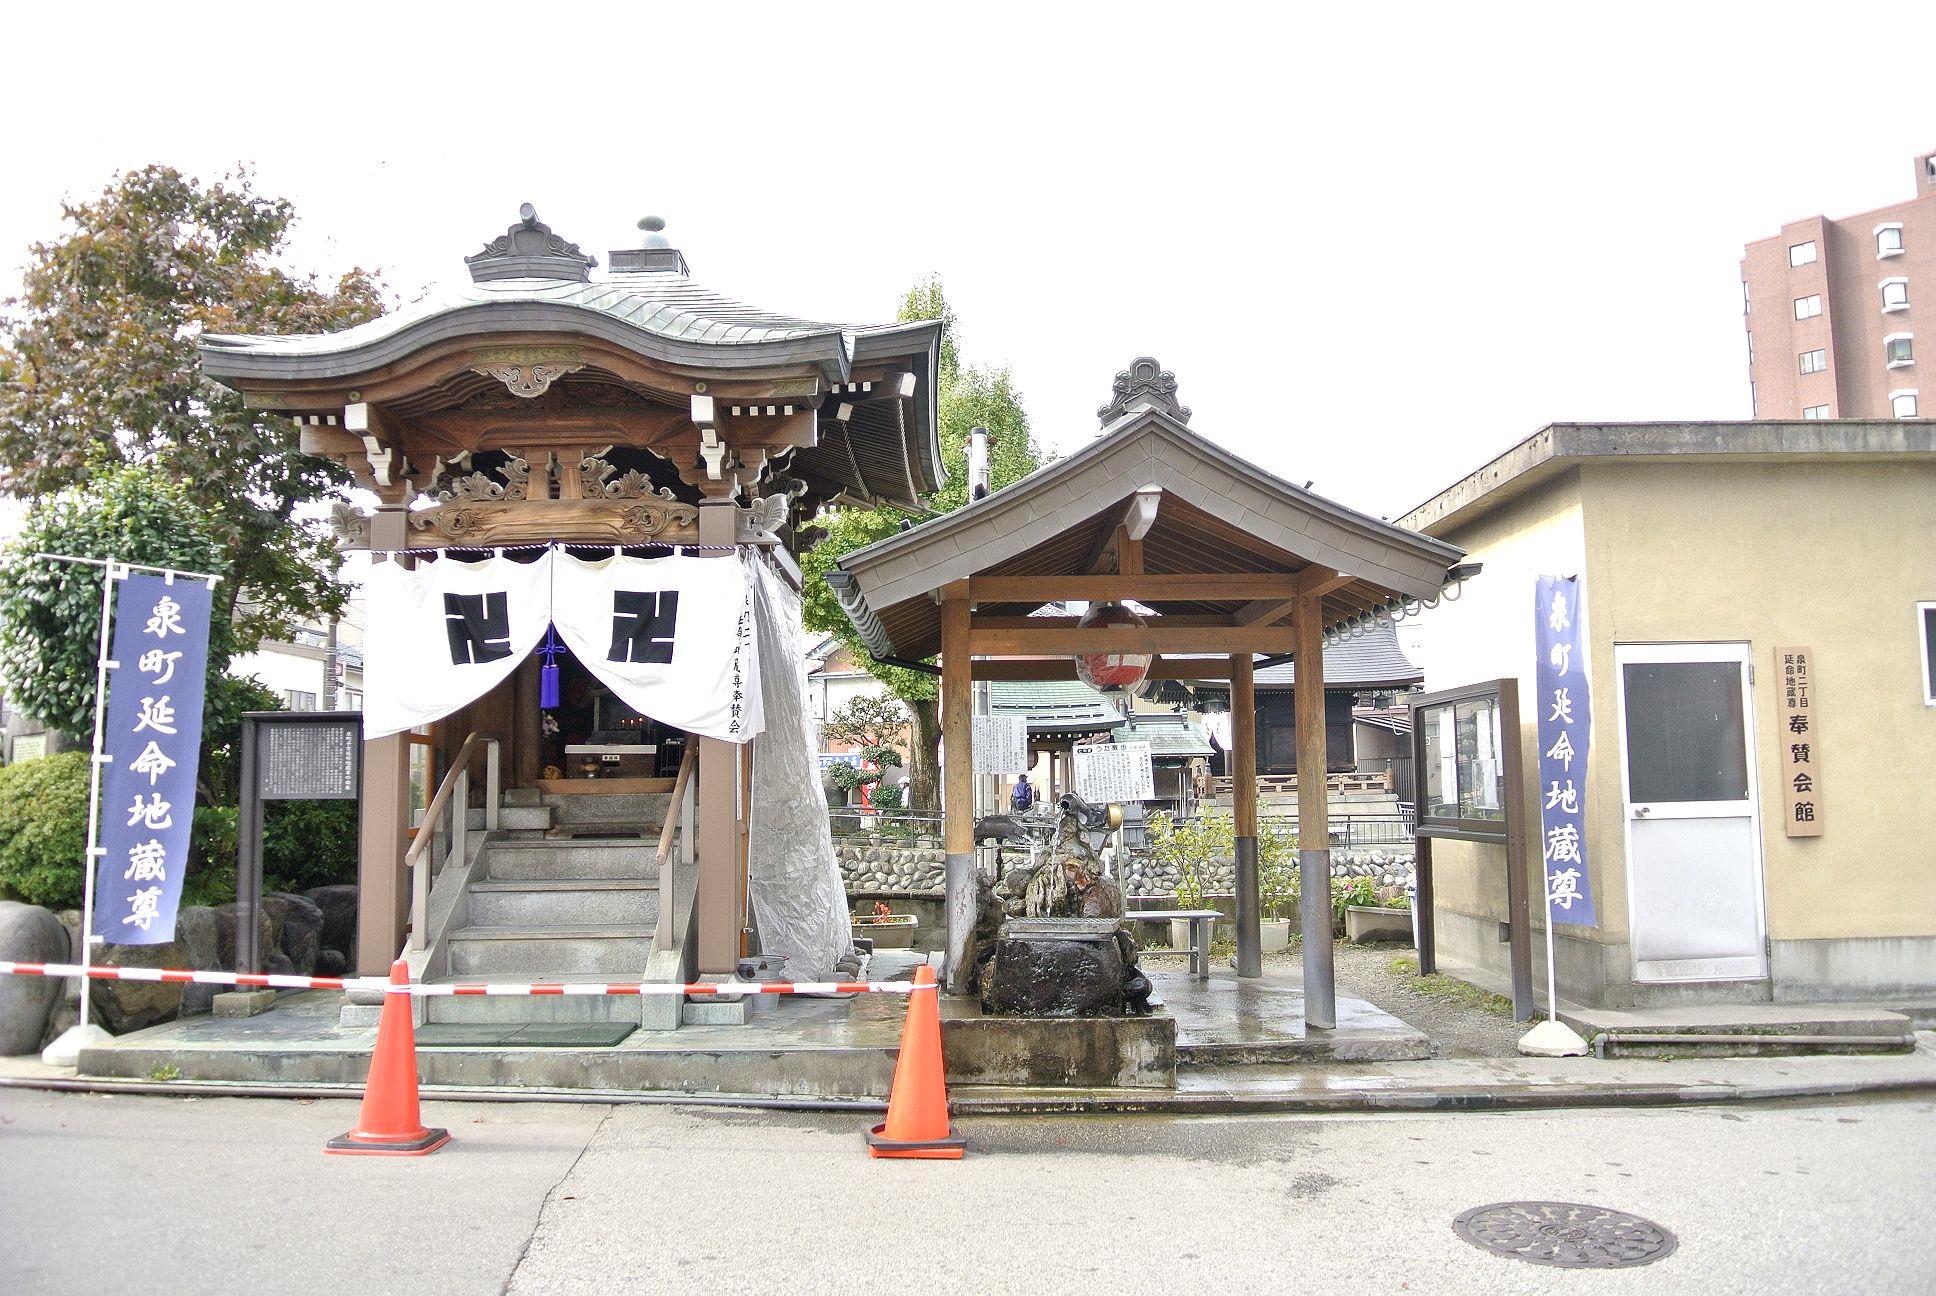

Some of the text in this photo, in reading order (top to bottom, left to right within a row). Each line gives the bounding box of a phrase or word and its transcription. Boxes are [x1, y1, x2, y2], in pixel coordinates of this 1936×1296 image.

[1784, 654, 1796, 709] 延命地蔵尊
[1796, 654, 1808, 708] 泉町二丁目
[122, 595, 186, 931] 泉町延命地蔵尊
[1546, 591, 1583, 909] 泉町延命地蔵尊
[1789, 714, 1815, 822] 奉賛会館
